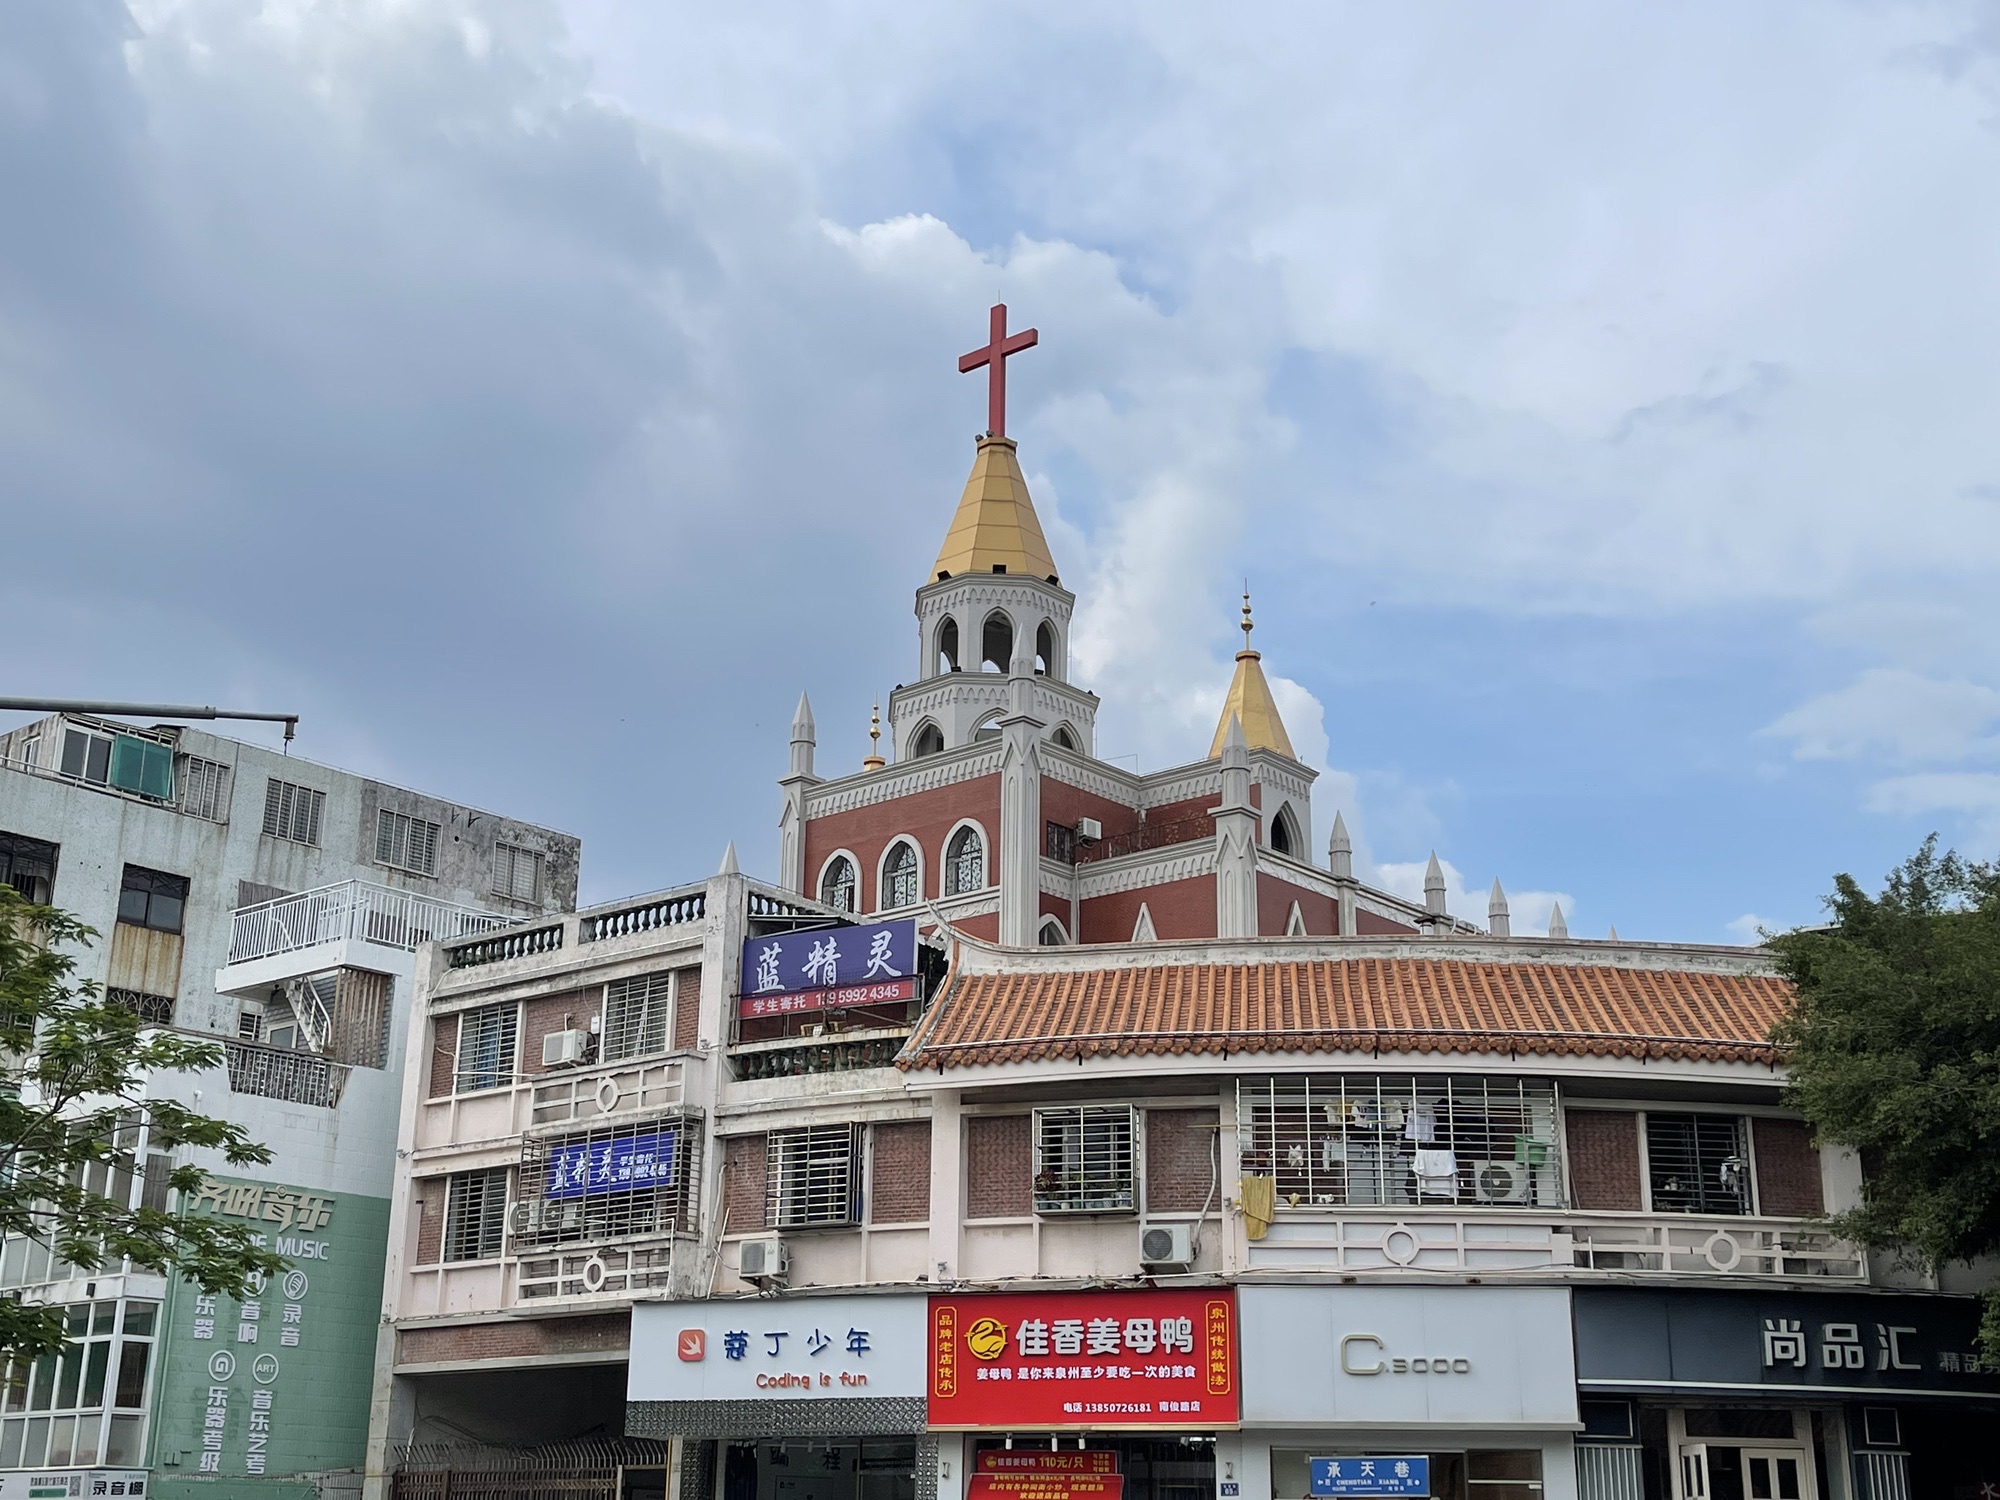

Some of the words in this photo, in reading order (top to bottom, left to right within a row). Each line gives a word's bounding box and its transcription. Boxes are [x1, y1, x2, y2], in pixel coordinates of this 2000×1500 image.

[752, 930, 902, 993] 蓝精灵
[753, 994, 807, 1014] 学生寄托
[838, 987, 868, 1005] 5992
[869, 984, 900, 1000] 4345
[275, 1236, 330, 1261] MUSIC
[193, 1294, 216, 1340] 乐器
[237, 1300, 260, 1344] 音响
[280, 1303, 302, 1347] 录音
[1015, 1316, 1194, 1357] 佳香姜母鸭
[724, 1327, 871, 1361] 蔻丁少年
[938, 1314, 954, 1391] 品牌老店传承
[1209, 1307, 1226, 1386] 泉州传统做法
[1763, 1318, 1922, 1371] 尚品汇
[756, 1372, 810, 1390] Coding
[819, 1372, 832, 1387] is
[839, 1371, 868, 1387] fun
[976, 1367, 1012, 1381] 姜母鸭
[1017, 1365, 1197, 1380] 是你来泉州至少要吃一次的美食
[1063, 1402, 1083, 1414] 电话
[1085, 1402, 1152, 1413] 13850726181
[199, 1385, 229, 1473] 乐器考级
[246, 1389, 273, 1475] 音乐艺考
[1039, 1456, 1085, 1469] 110元/只
[1327, 1461, 1410, 1478] 承天巷
[92, 1480, 144, 1496] 录音棚
